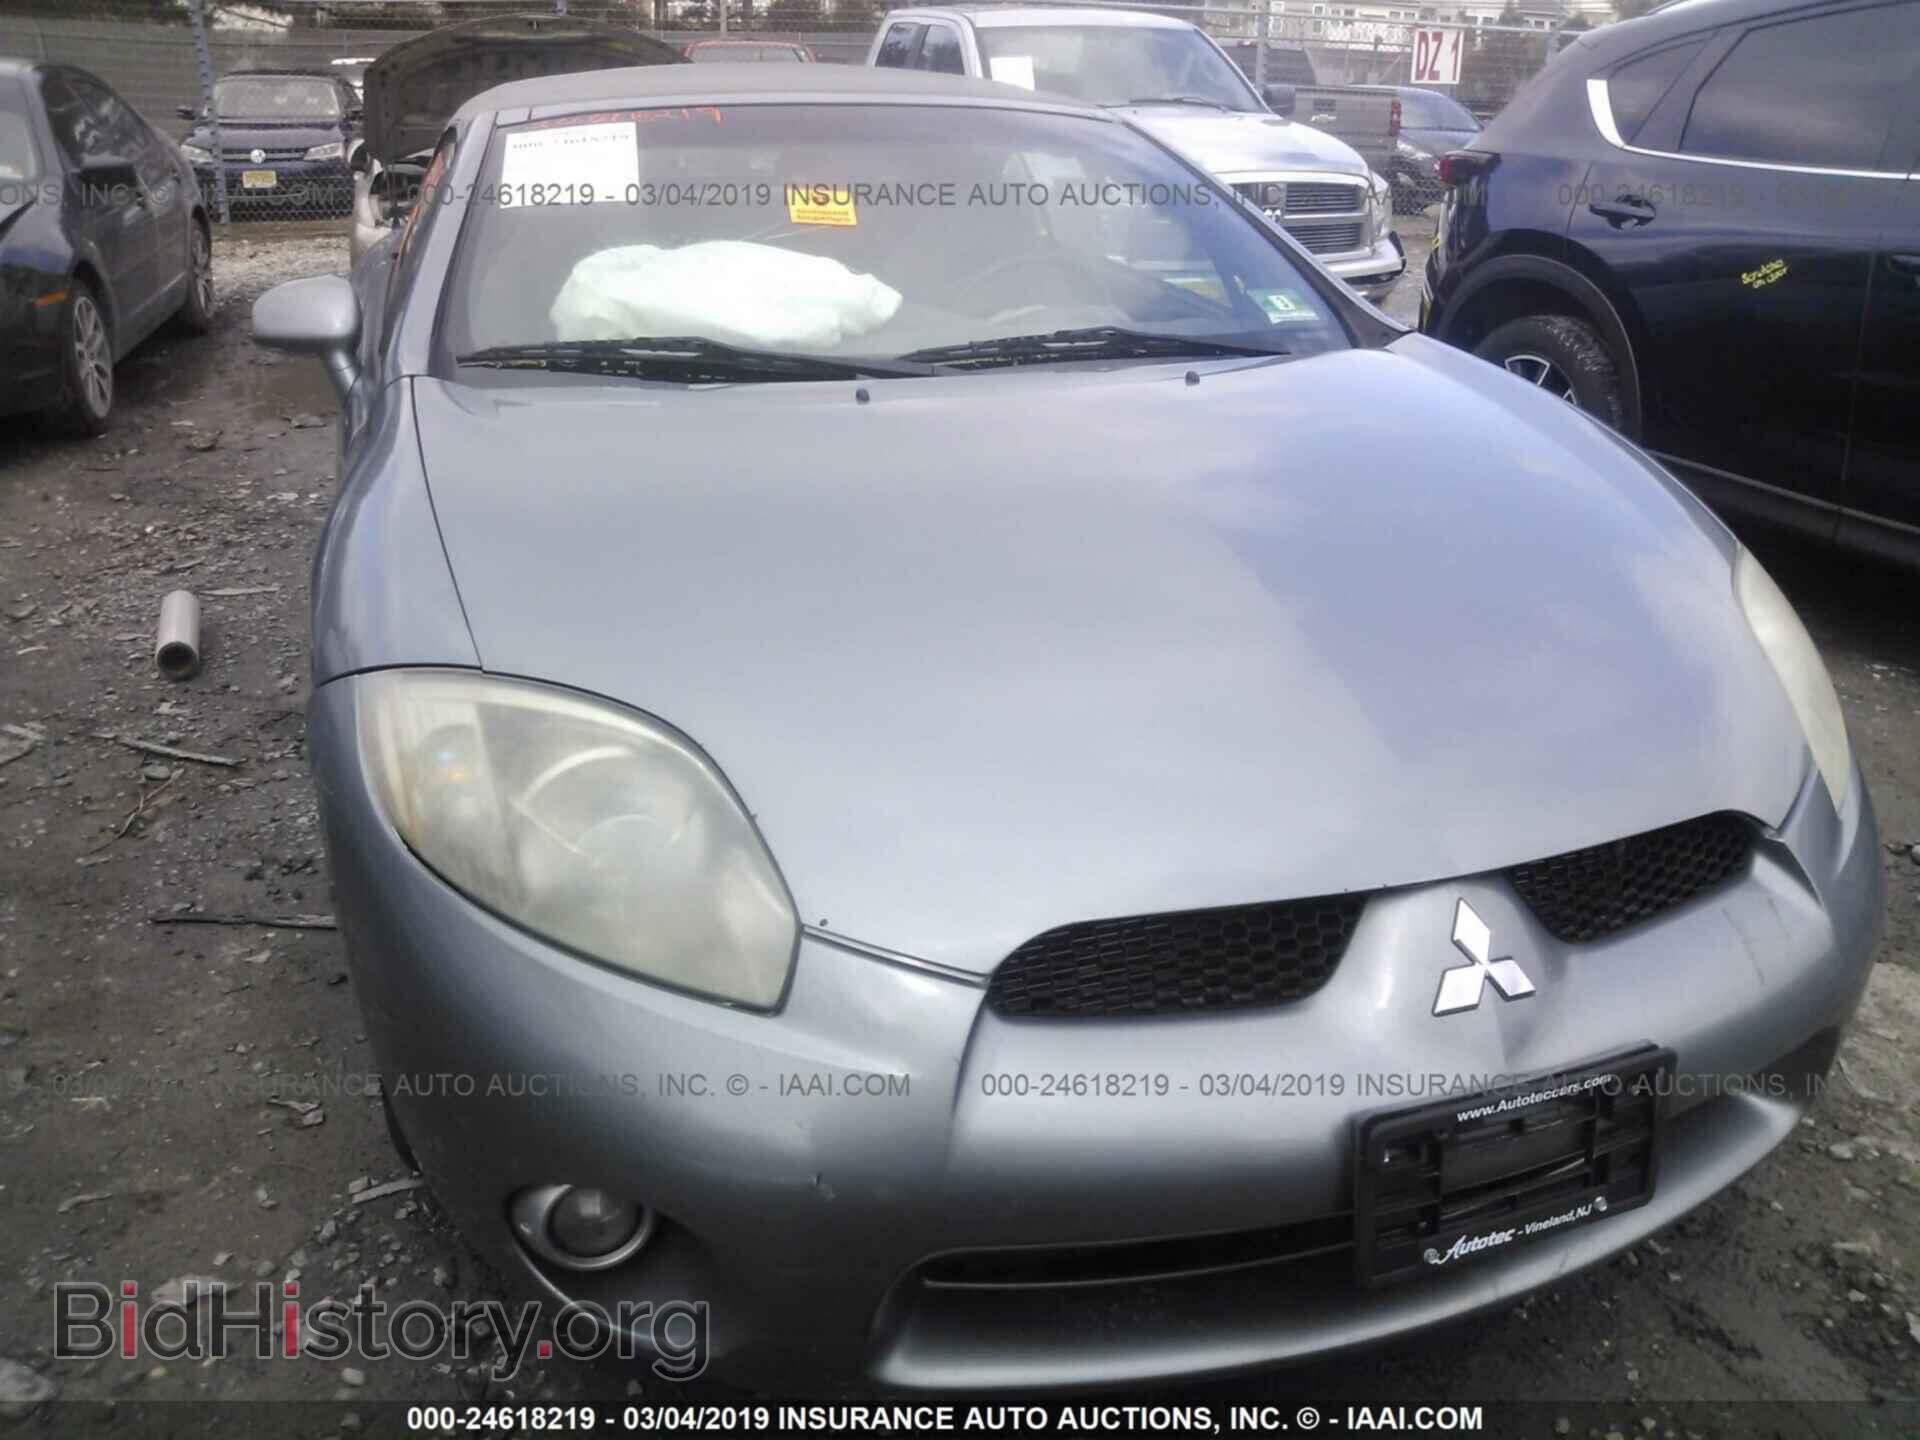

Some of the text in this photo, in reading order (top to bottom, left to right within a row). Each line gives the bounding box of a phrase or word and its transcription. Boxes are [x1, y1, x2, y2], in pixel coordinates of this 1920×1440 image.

[1417, 31, 1461, 82] DZ 1
[1434, 1228, 1516, 1265] Autotec
